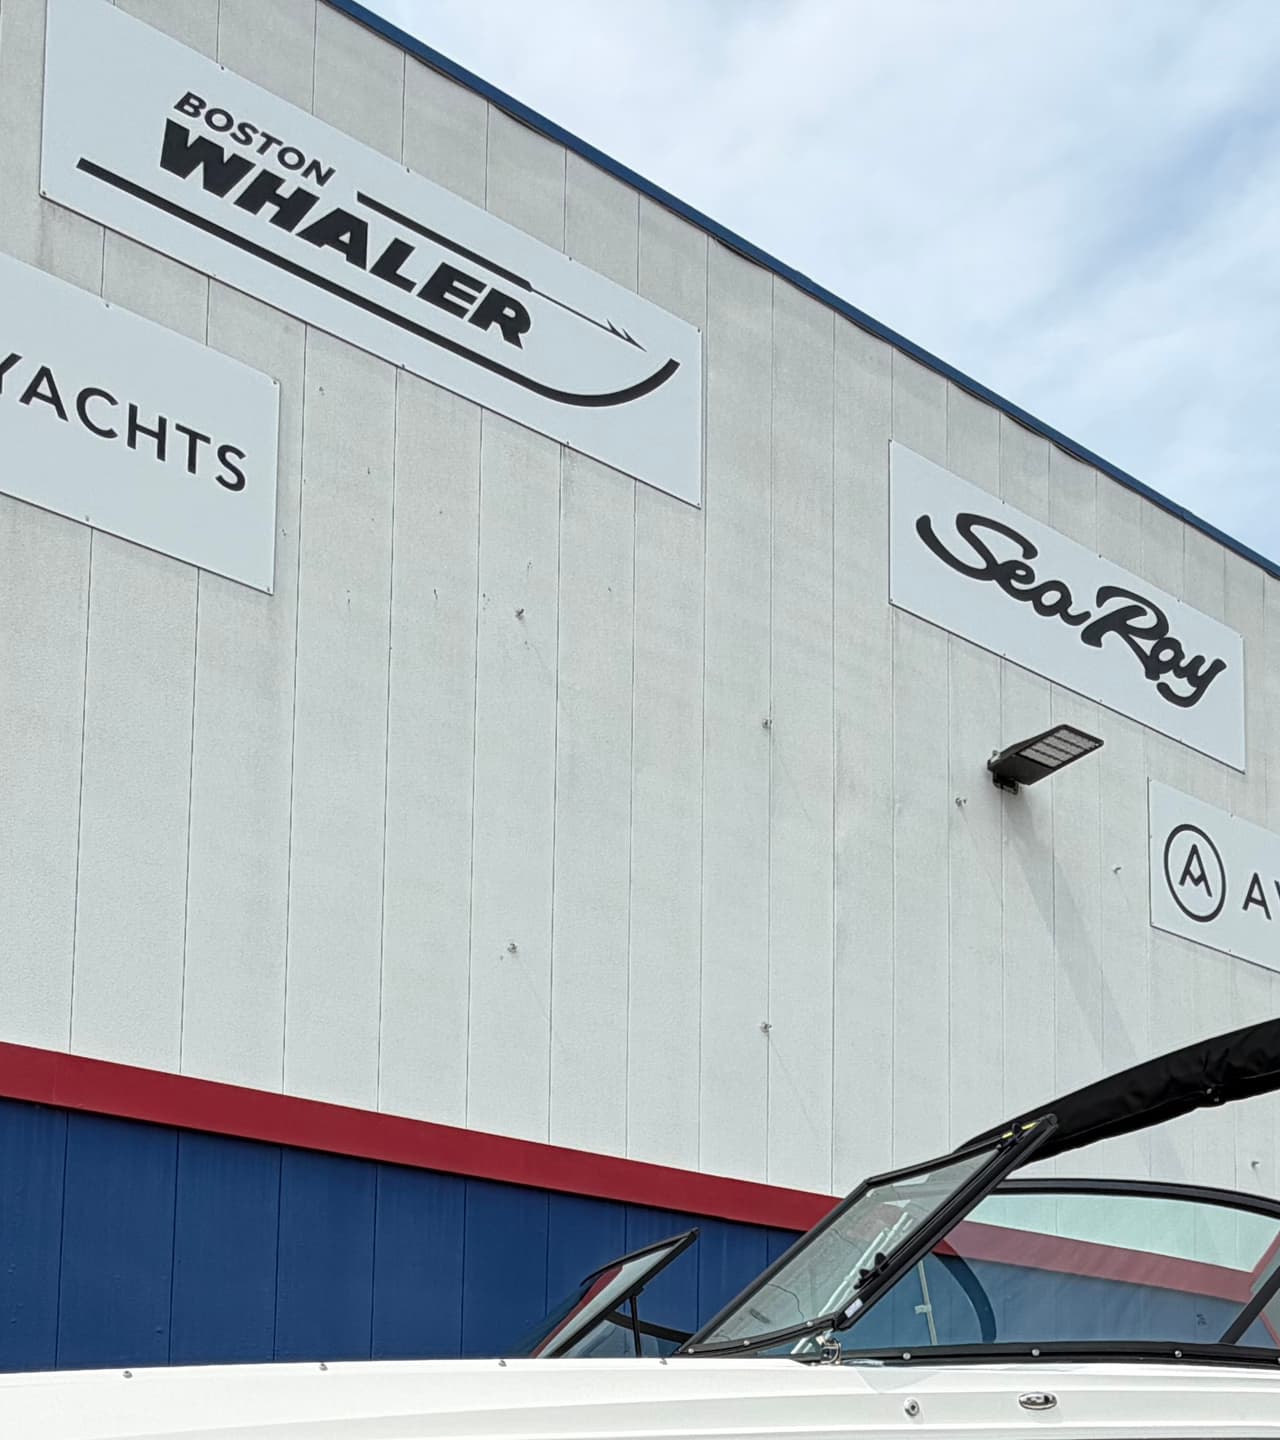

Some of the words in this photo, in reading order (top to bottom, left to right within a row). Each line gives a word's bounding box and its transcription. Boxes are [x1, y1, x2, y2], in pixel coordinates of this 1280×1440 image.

[159, 117, 531, 349] WHALER
[173, 91, 336, 187] BOSTON
[915, 512, 1092, 626] Sea
[1080, 585, 1227, 708] Ray
